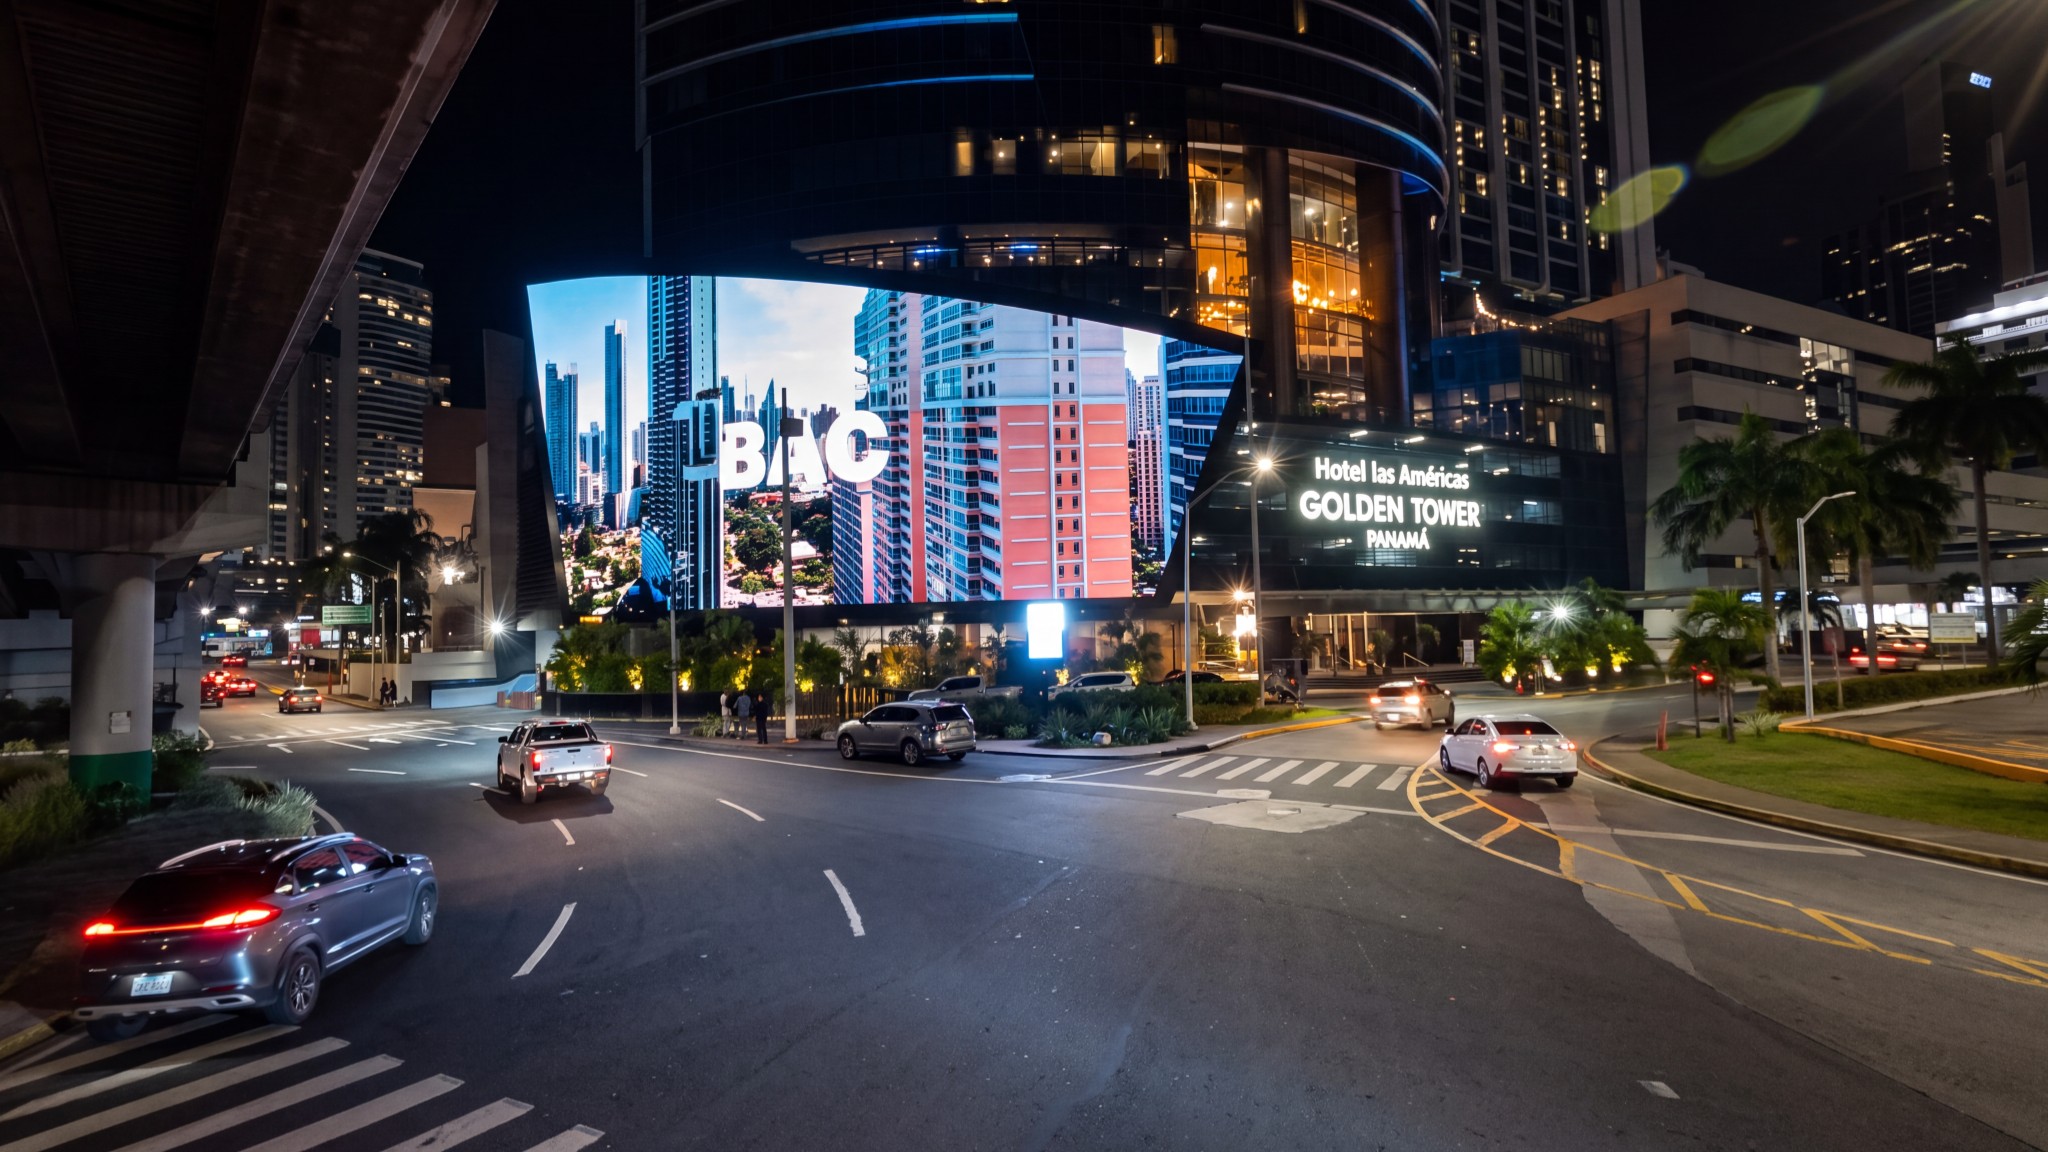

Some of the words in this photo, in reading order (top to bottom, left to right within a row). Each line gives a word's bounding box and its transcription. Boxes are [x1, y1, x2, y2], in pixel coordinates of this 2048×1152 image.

[722, 410, 890, 490] BAC
[1314, 456, 1367, 483] Hotel
[1371, 460, 1396, 485] las
[1399, 464, 1470, 490] Américas
[1299, 490, 1404, 524] GOLDEN
[1410, 497, 1481, 528] TOWER
[1366, 526, 1431, 550] PANAMÁ
